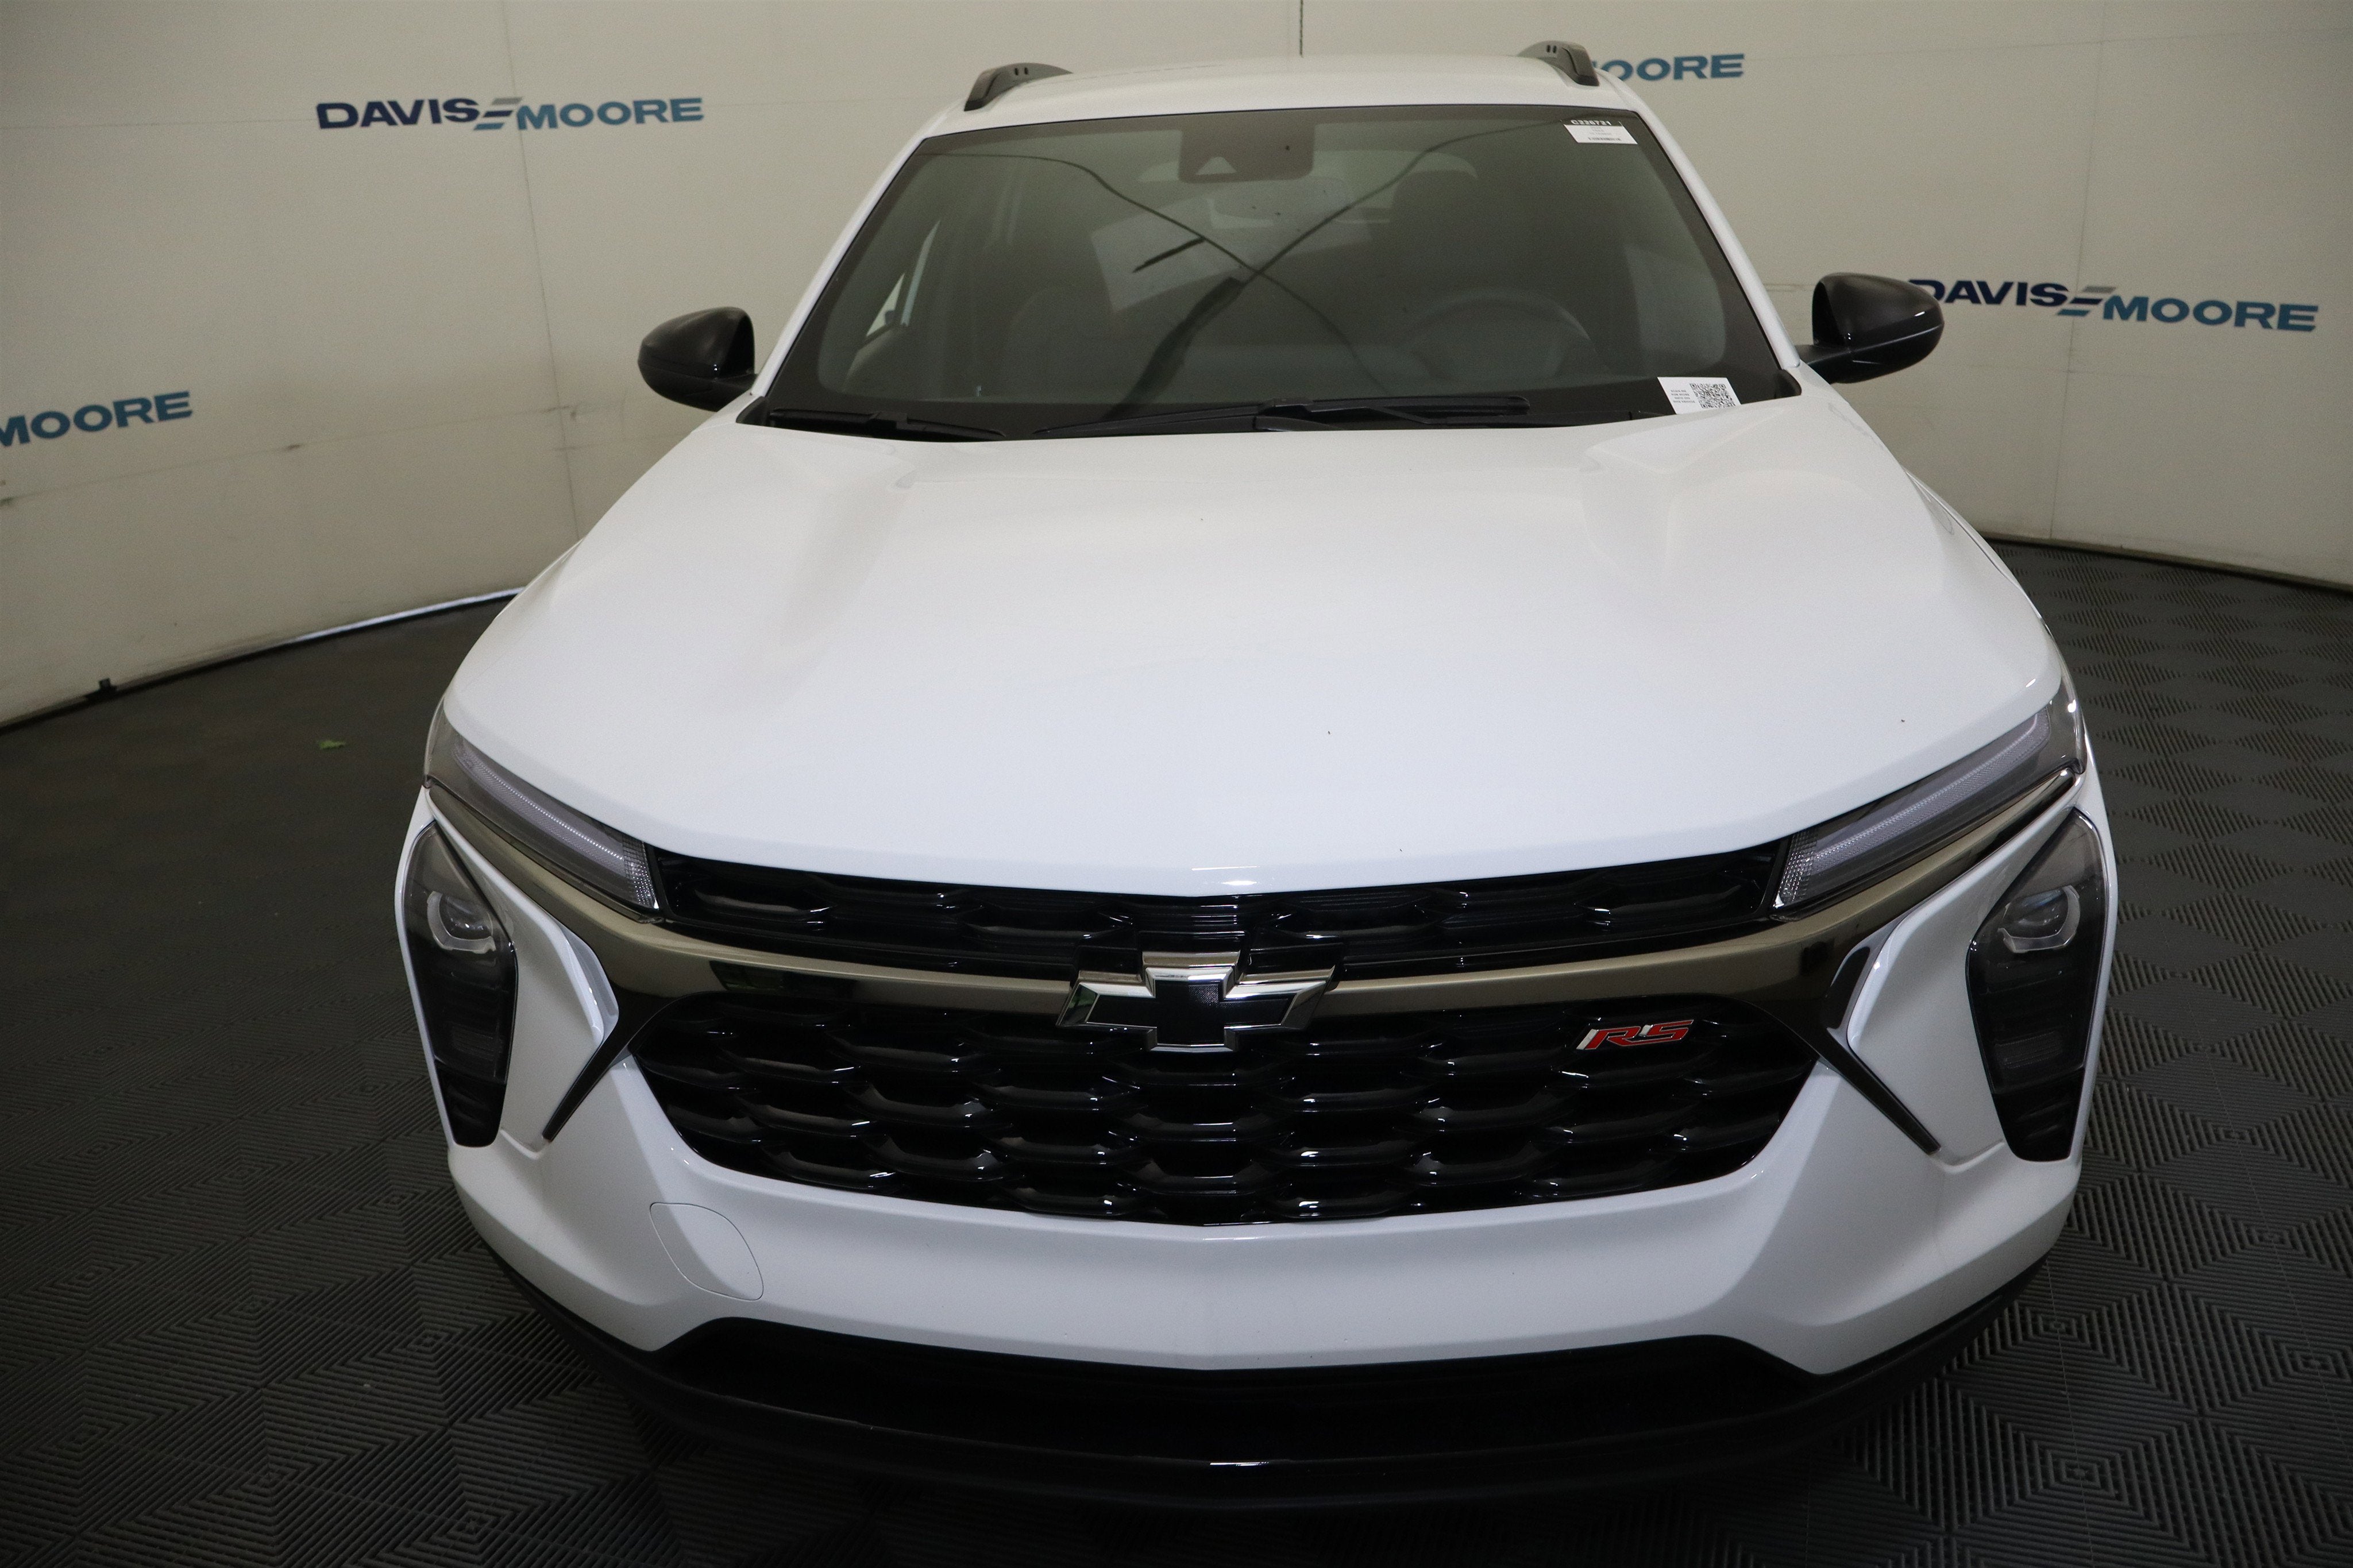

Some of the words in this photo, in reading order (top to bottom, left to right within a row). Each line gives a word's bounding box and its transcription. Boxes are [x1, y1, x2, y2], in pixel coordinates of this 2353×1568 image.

[1592, 53, 1745, 81] OORE
[316, 98, 480, 129] DAVIS
[516, 98, 704, 130] MOORE
[2103, 295, 2319, 331] MOORE
[1576, 1019, 1694, 1050] RS
